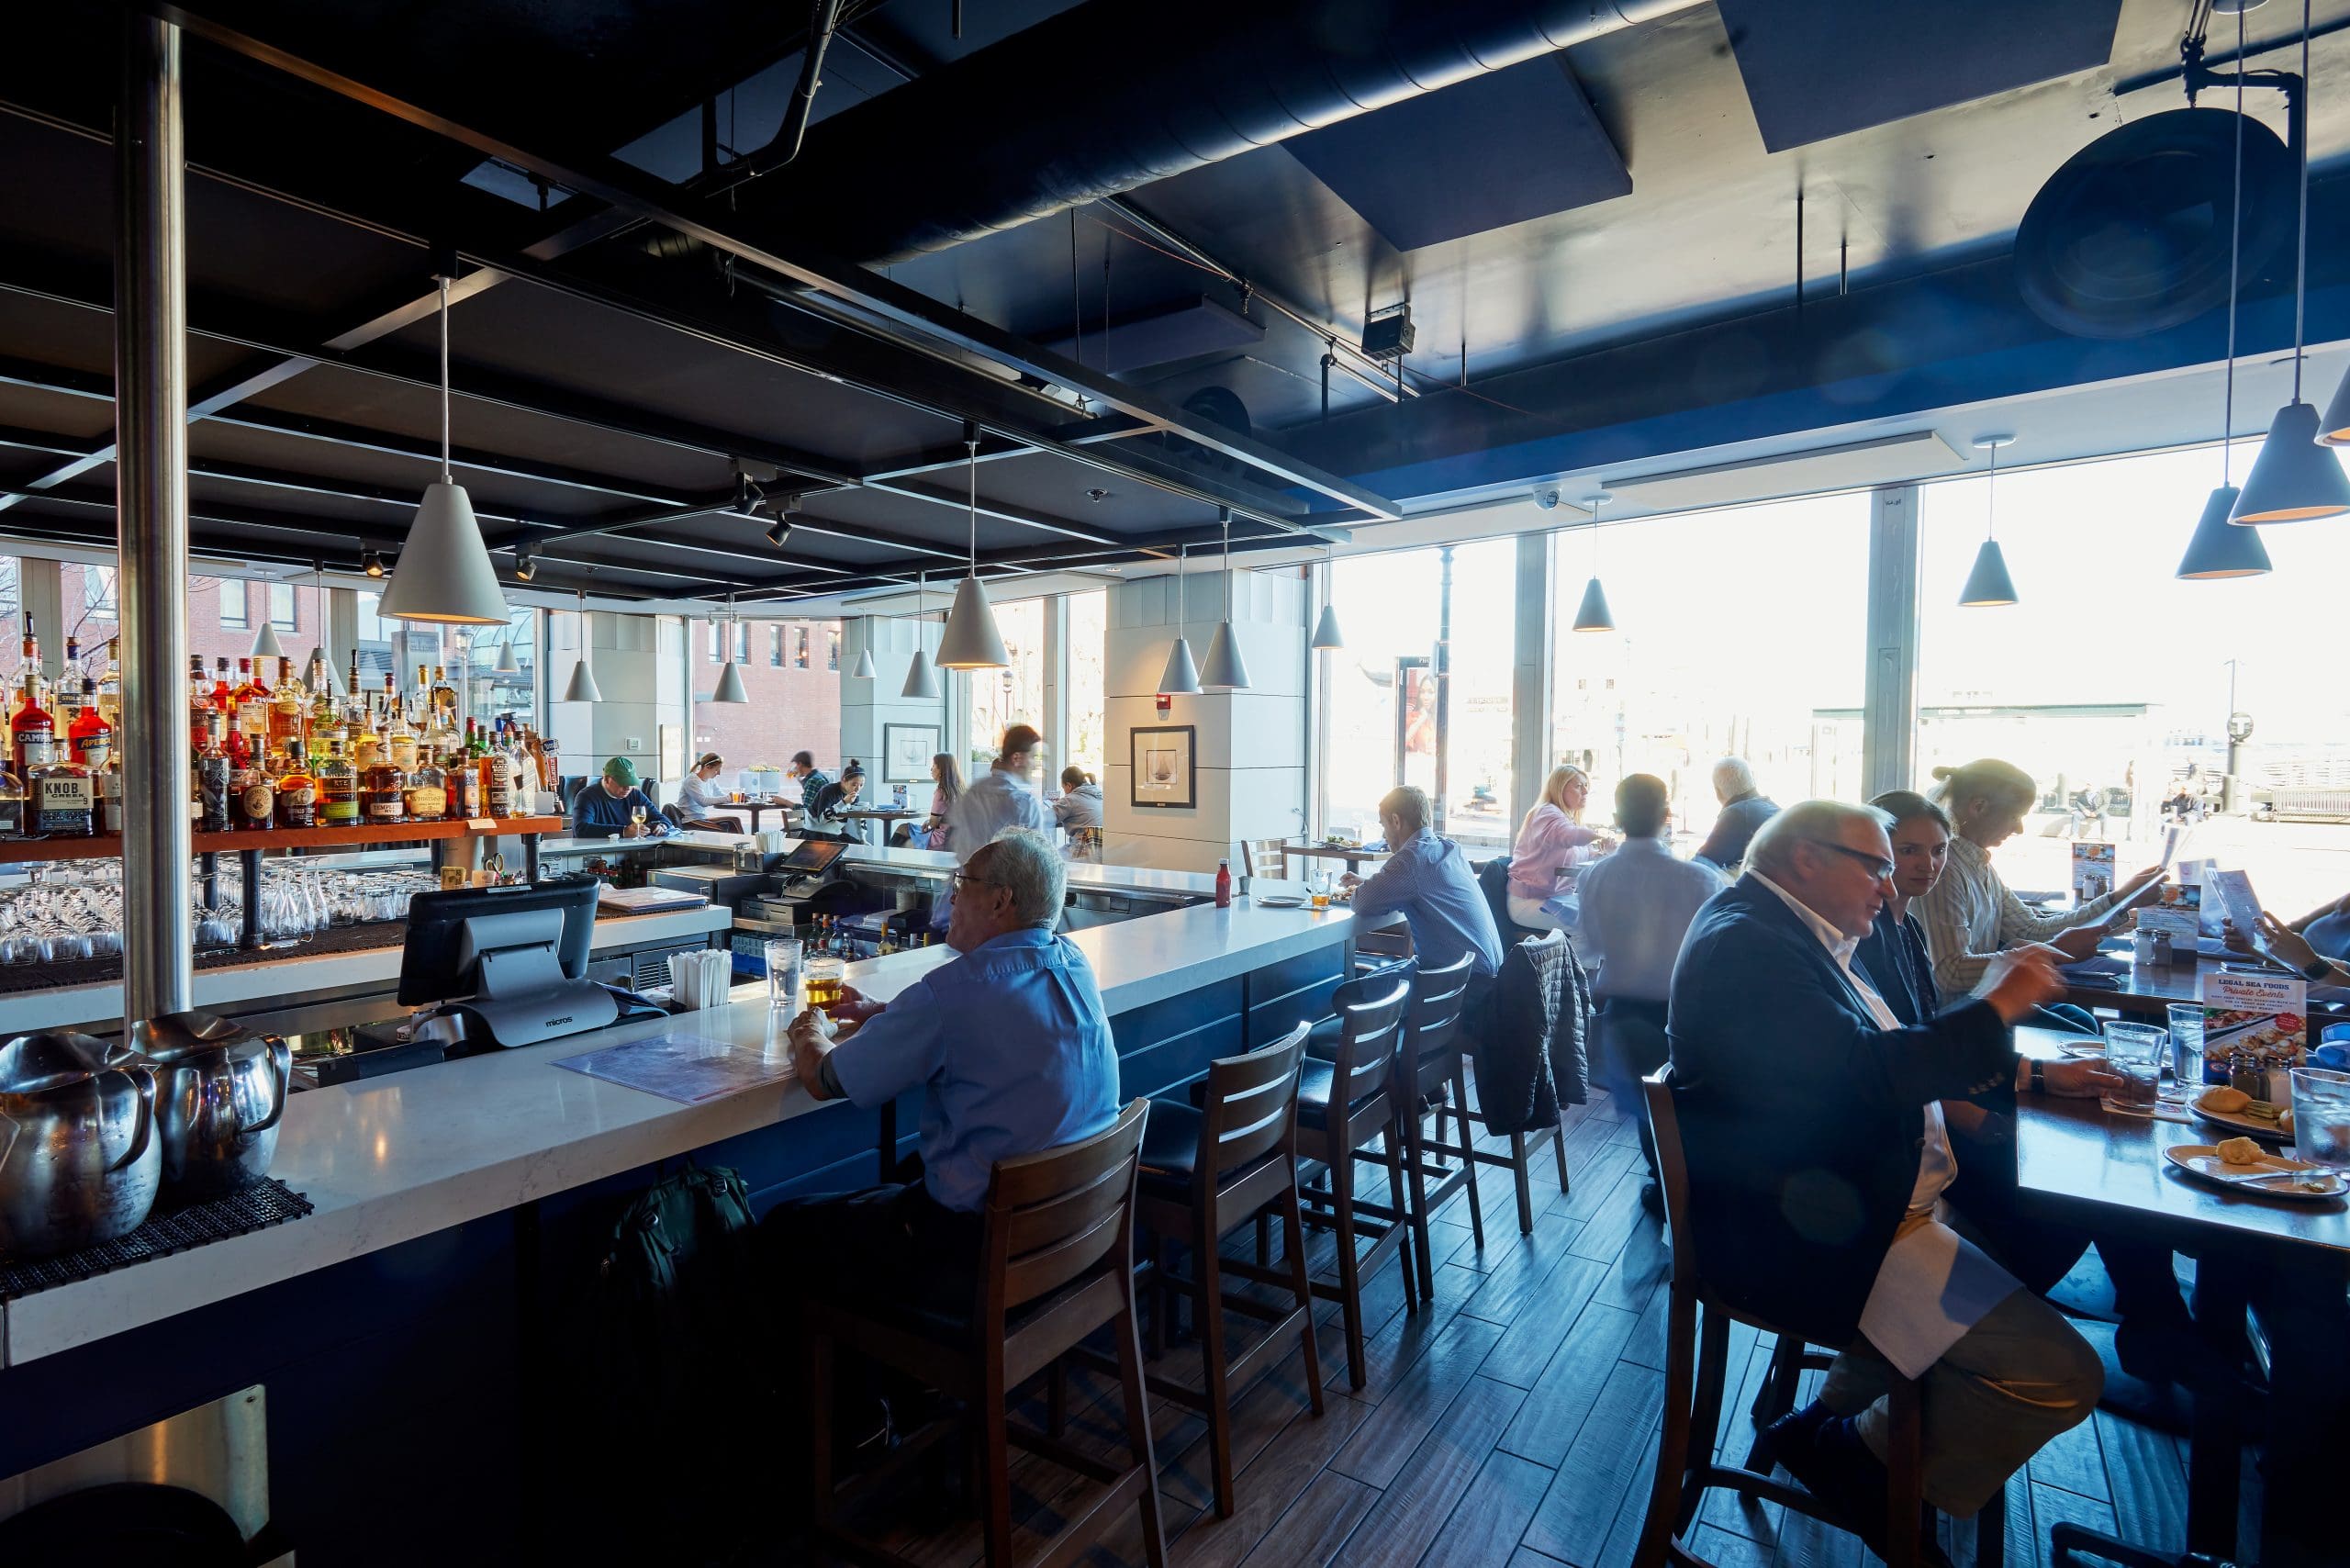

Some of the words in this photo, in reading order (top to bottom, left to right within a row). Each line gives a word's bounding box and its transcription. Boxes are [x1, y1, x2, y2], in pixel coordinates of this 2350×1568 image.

[45, 782, 79, 794] KNOB
[83, 797, 88, 805] 9
[2218, 979, 2244, 987] LEGAL
[2264, 982, 2290, 991] FOODS
[2222, 985, 2255, 996] Private
[2255, 989, 2285, 999] Events
[545, 1016, 573, 1027] micros
